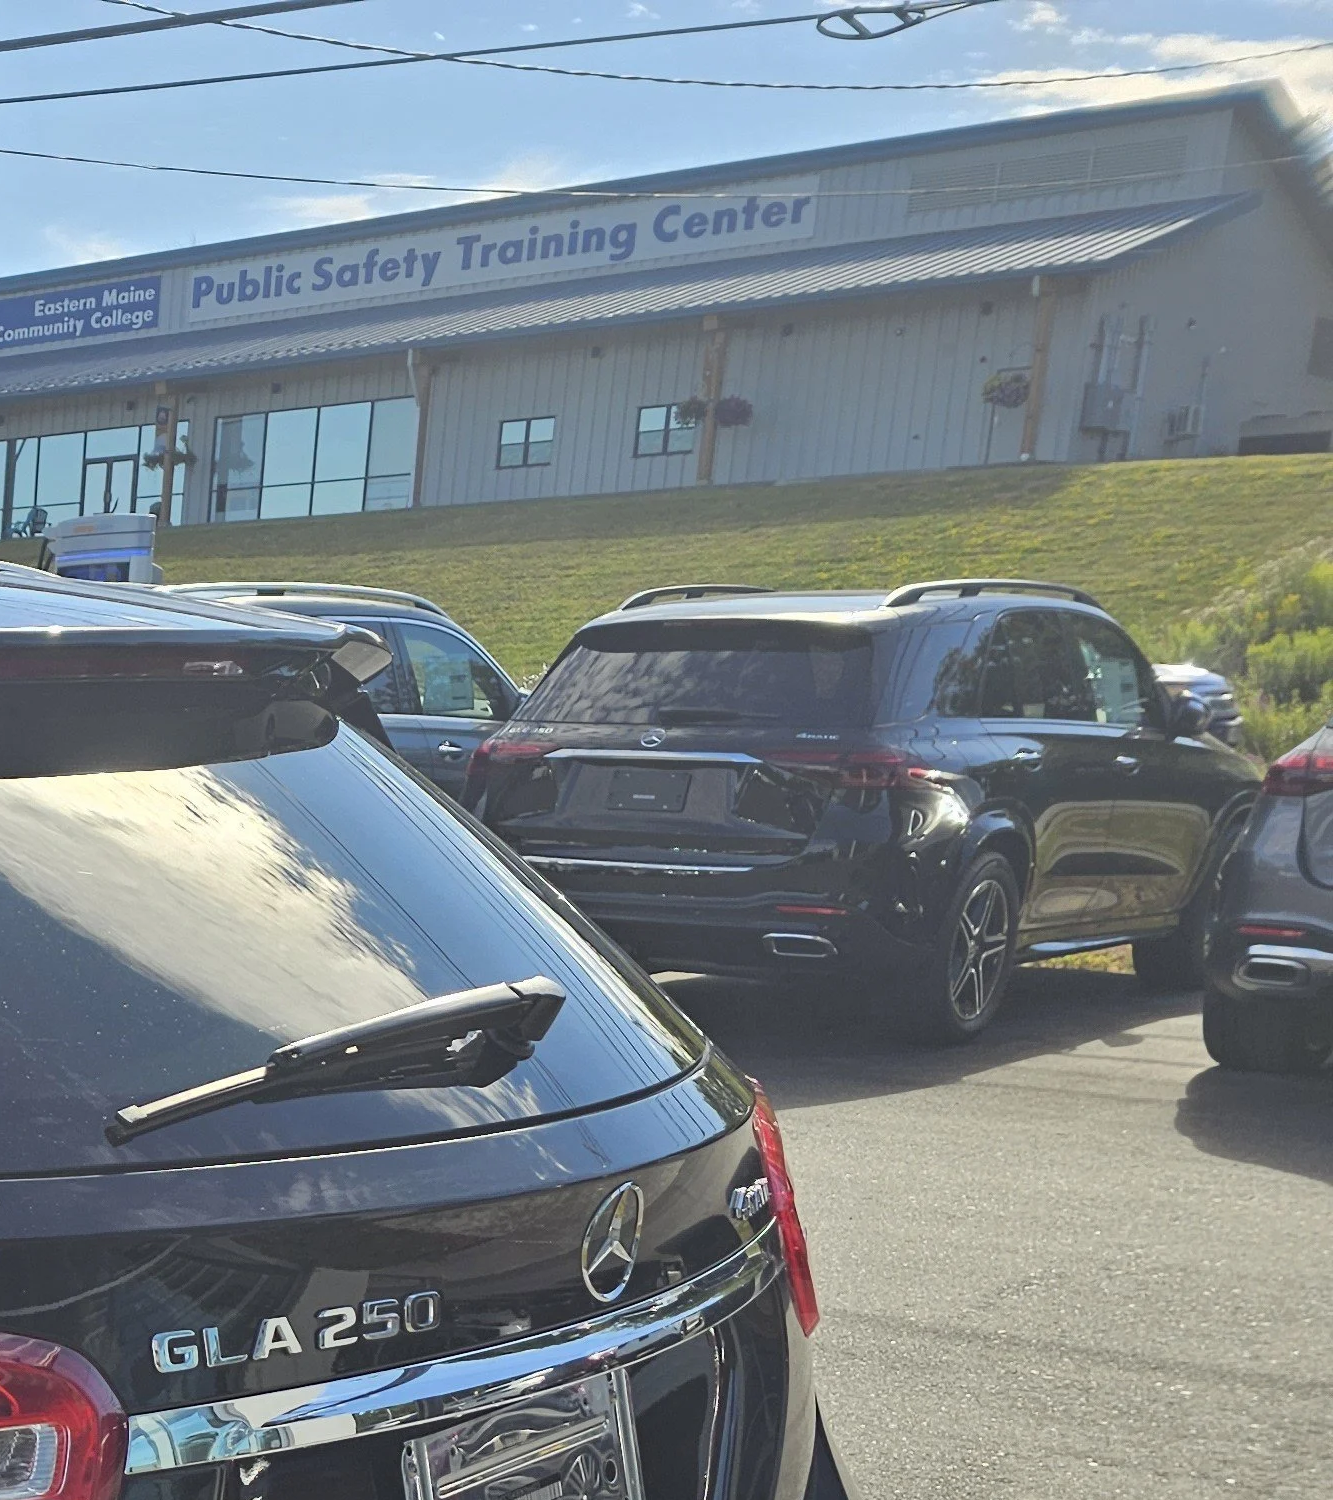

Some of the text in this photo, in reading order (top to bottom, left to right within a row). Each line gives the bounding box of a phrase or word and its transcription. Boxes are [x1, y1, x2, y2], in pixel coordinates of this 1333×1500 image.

[191, 196, 812, 309] Public Safety Training Center
[34, 285, 156, 317] Eastern Maine
[90, 308, 154, 329] College
[151, 1290, 442, 1373] GLA 250
